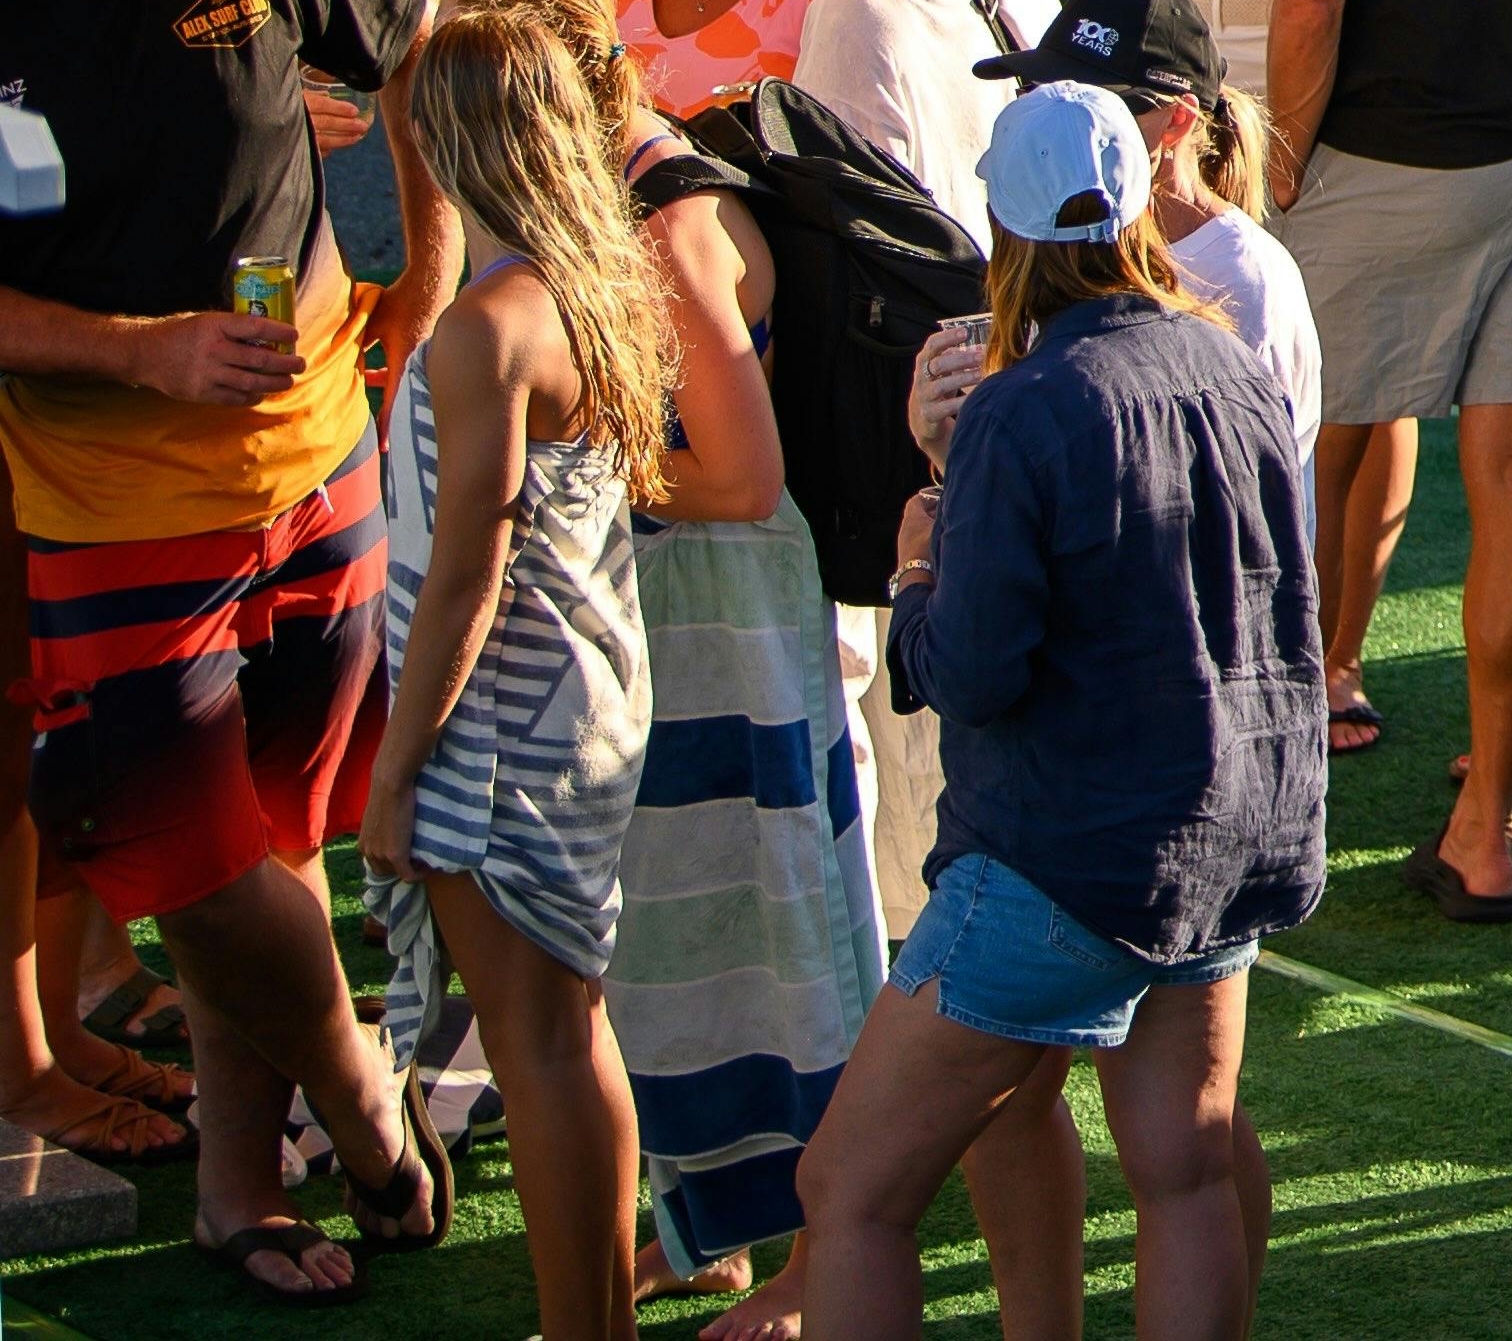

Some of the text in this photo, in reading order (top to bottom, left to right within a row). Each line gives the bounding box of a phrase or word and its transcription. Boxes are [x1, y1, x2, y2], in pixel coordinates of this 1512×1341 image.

[181, 15, 212, 39] ALEX
[209, 3, 239, 27] SURF
[1071, 32, 1113, 56] YEARS
